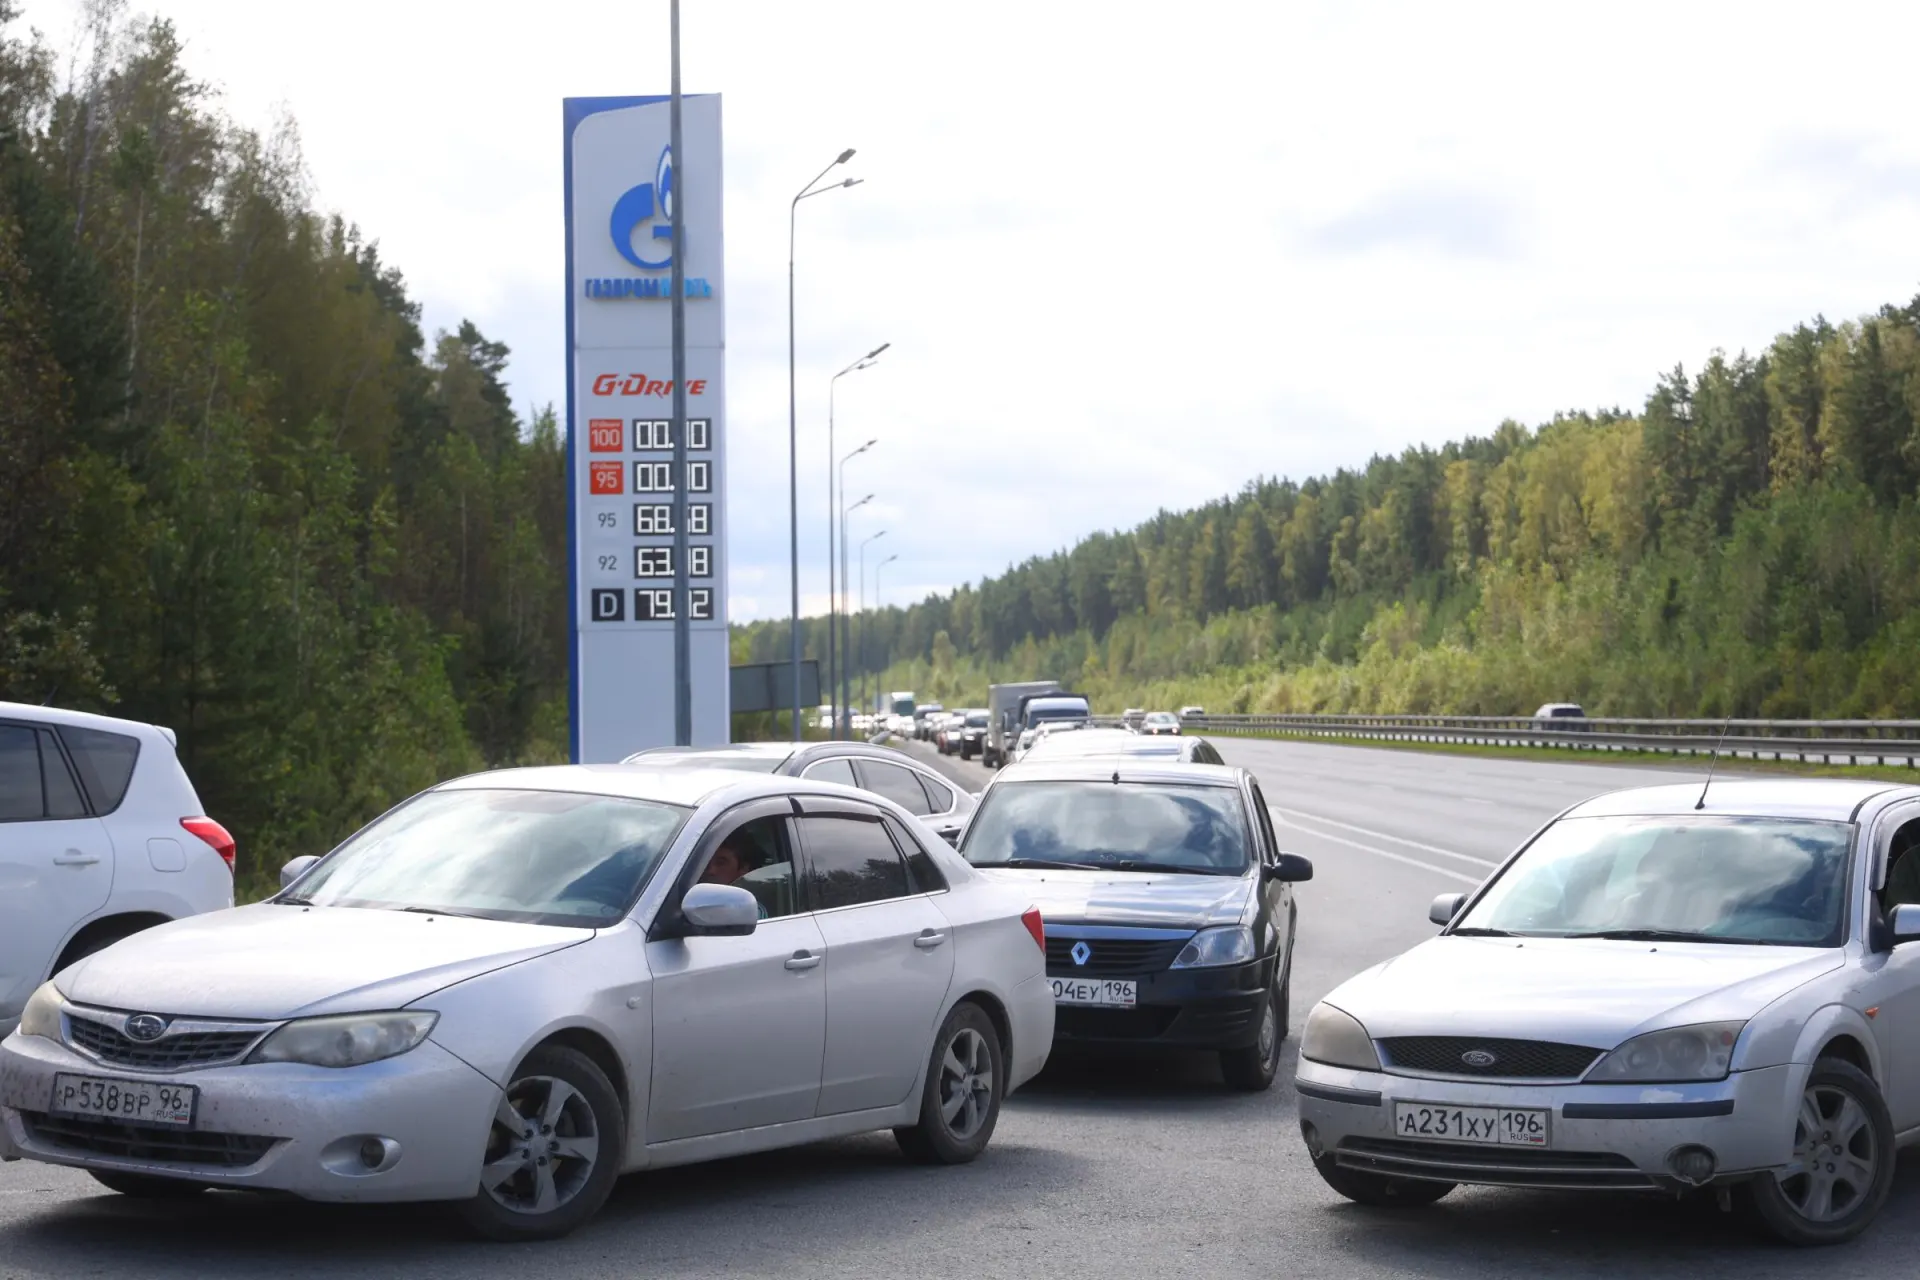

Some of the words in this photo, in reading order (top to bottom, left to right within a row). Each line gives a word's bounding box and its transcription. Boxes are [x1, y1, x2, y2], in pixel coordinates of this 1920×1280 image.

[585, 278, 712, 298] ГАЗПРОМНФТЬ
[591, 429, 620, 446] 100
[636, 421, 707, 448] 00.0
[596, 471, 617, 488] 95
[637, 463, 707, 491] 00.0
[598, 513, 616, 527] 95
[637, 505, 708, 533] 68.8
[598, 555, 617, 570] 92
[638, 547, 708, 576] 63.8
[599, 592, 618, 617] D
[638, 590, 709, 618] 79.2
[1047, 980, 1099, 1000] 04ЕУ
[1104, 981, 1132, 996] 196
[160, 1088, 182, 1109] 96
[156, 1110, 174, 1119] RUS
[1502, 1112, 1540, 1132] 196
[1510, 1132, 1529, 1141] RUS
